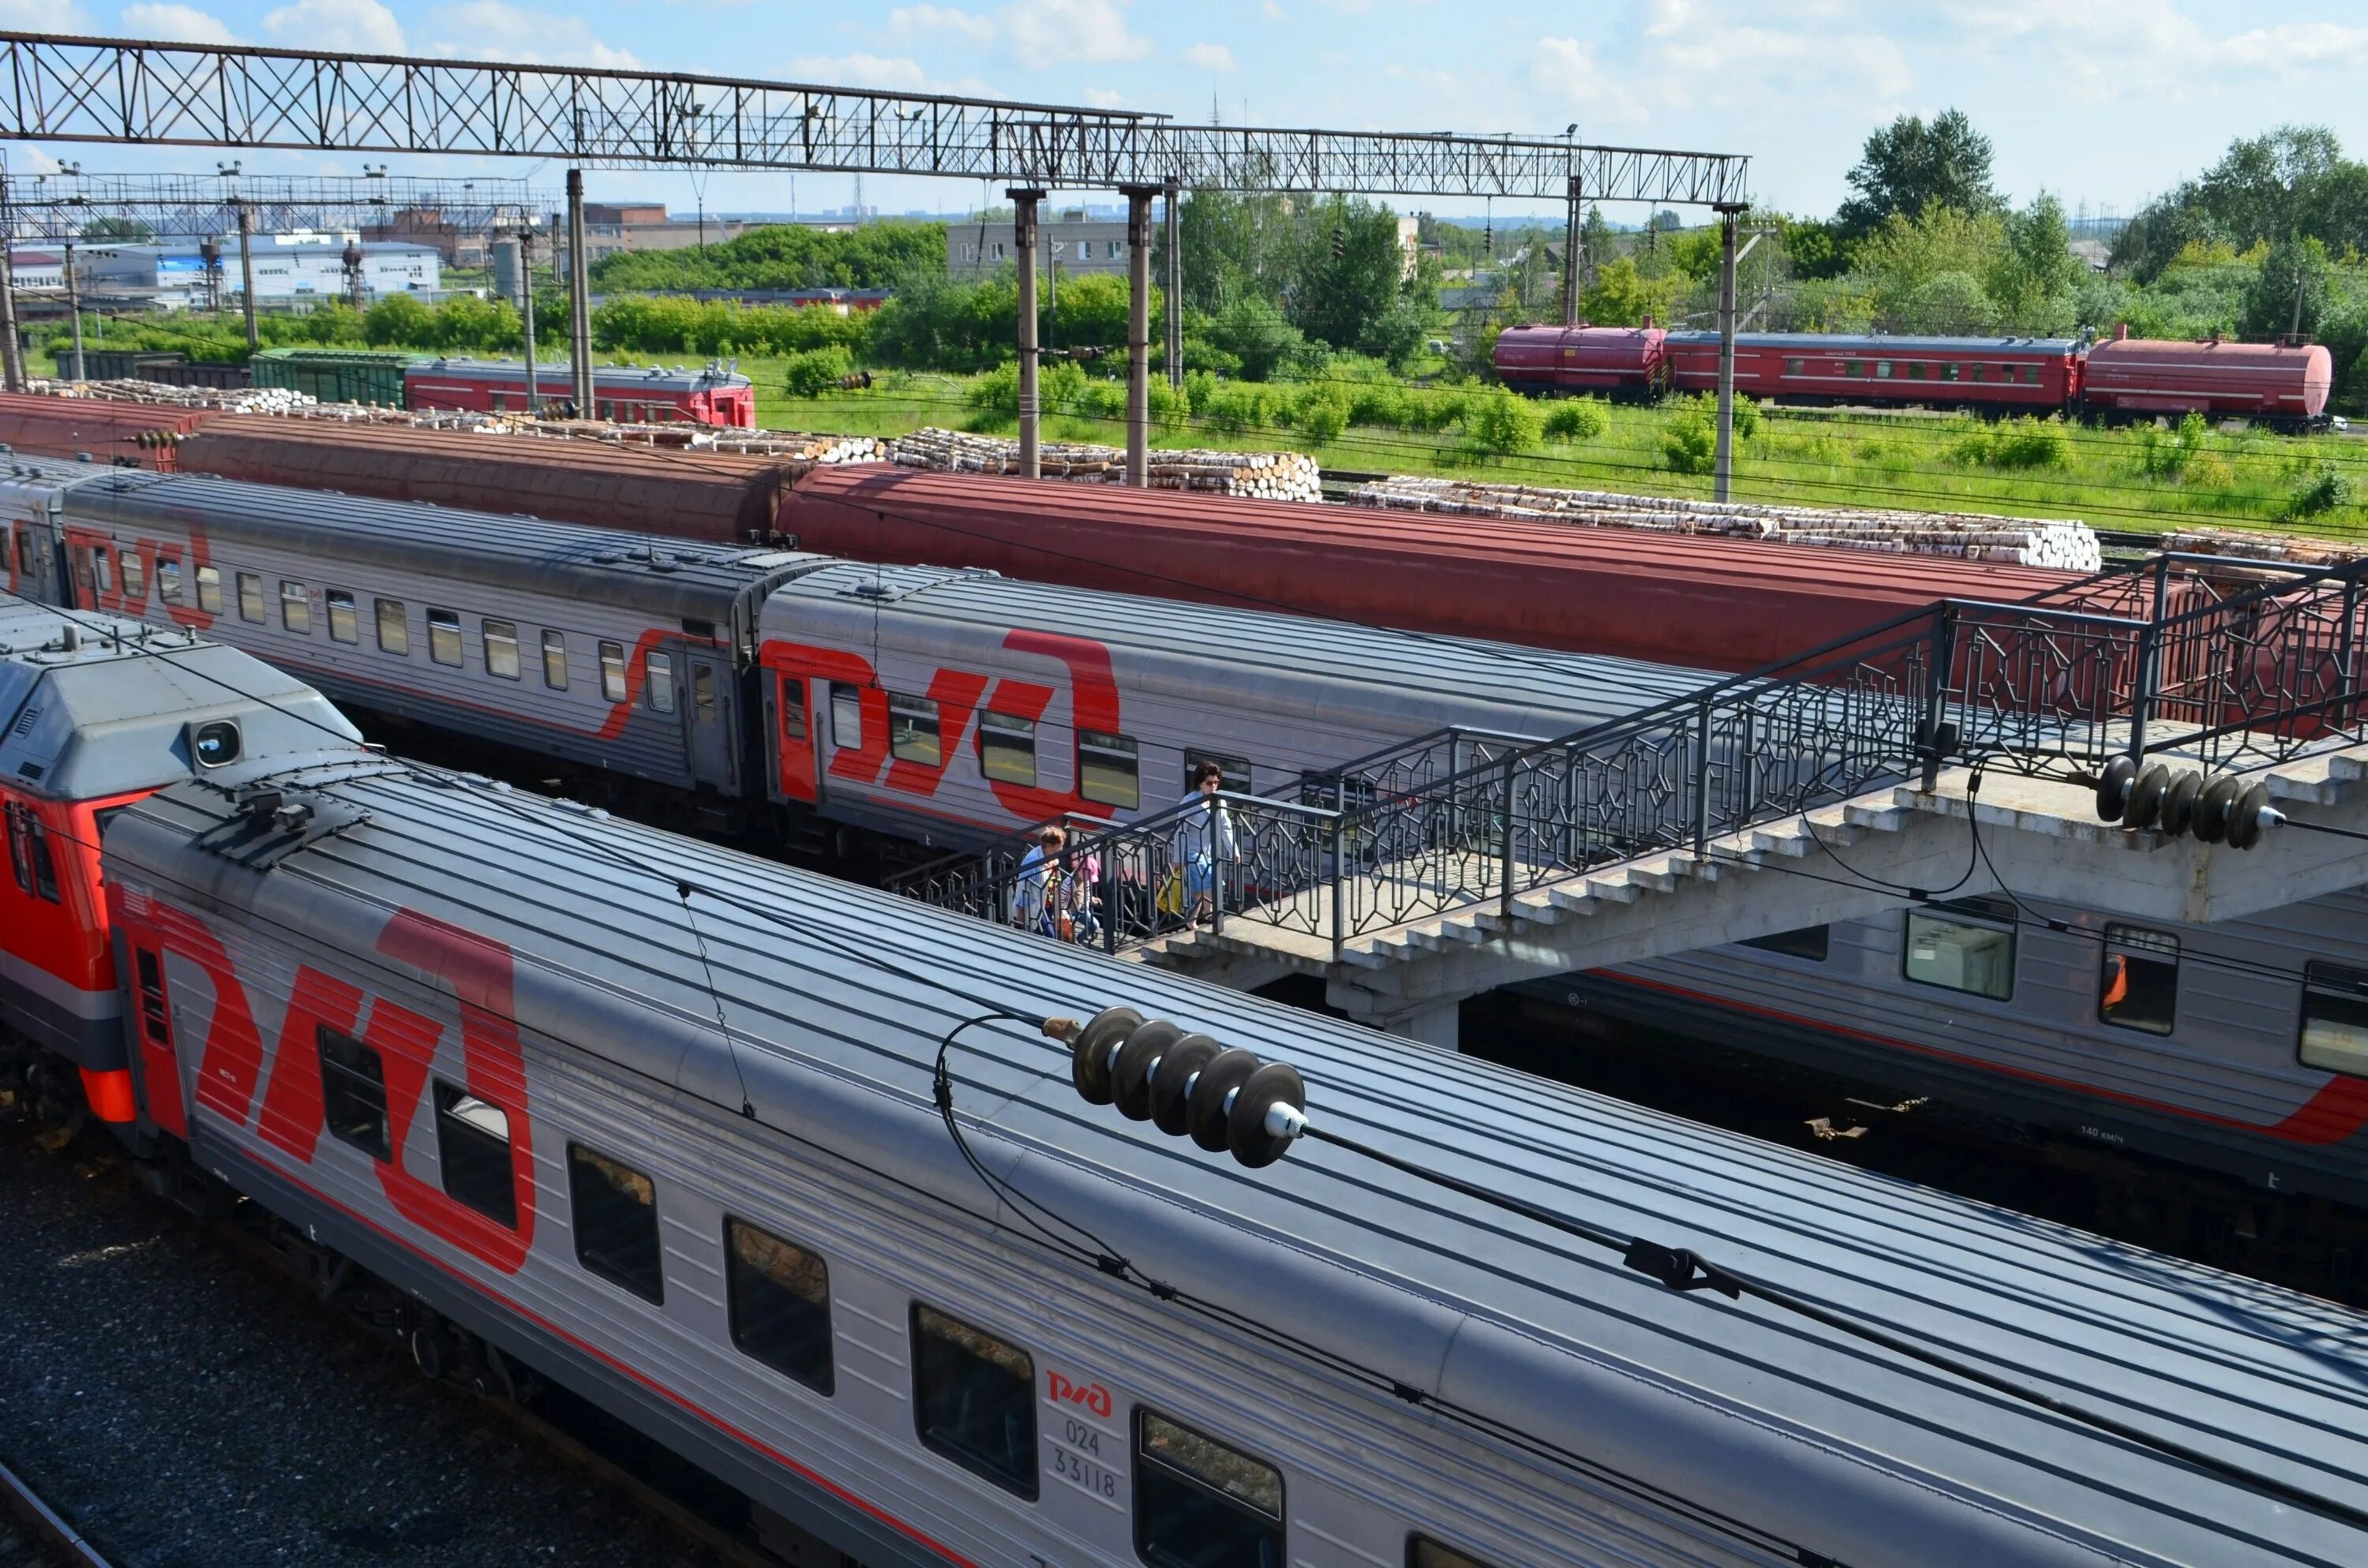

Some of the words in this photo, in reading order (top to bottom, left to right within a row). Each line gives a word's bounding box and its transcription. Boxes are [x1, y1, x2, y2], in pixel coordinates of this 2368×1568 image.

[2081, 1125, 2099, 1137] 140
[2100, 1132, 2123, 1143] км/ч
[1047, 1369, 1111, 1418] РЖД
[1066, 1420, 1100, 1457] 024
[1055, 1446, 1115, 1498] 33118
